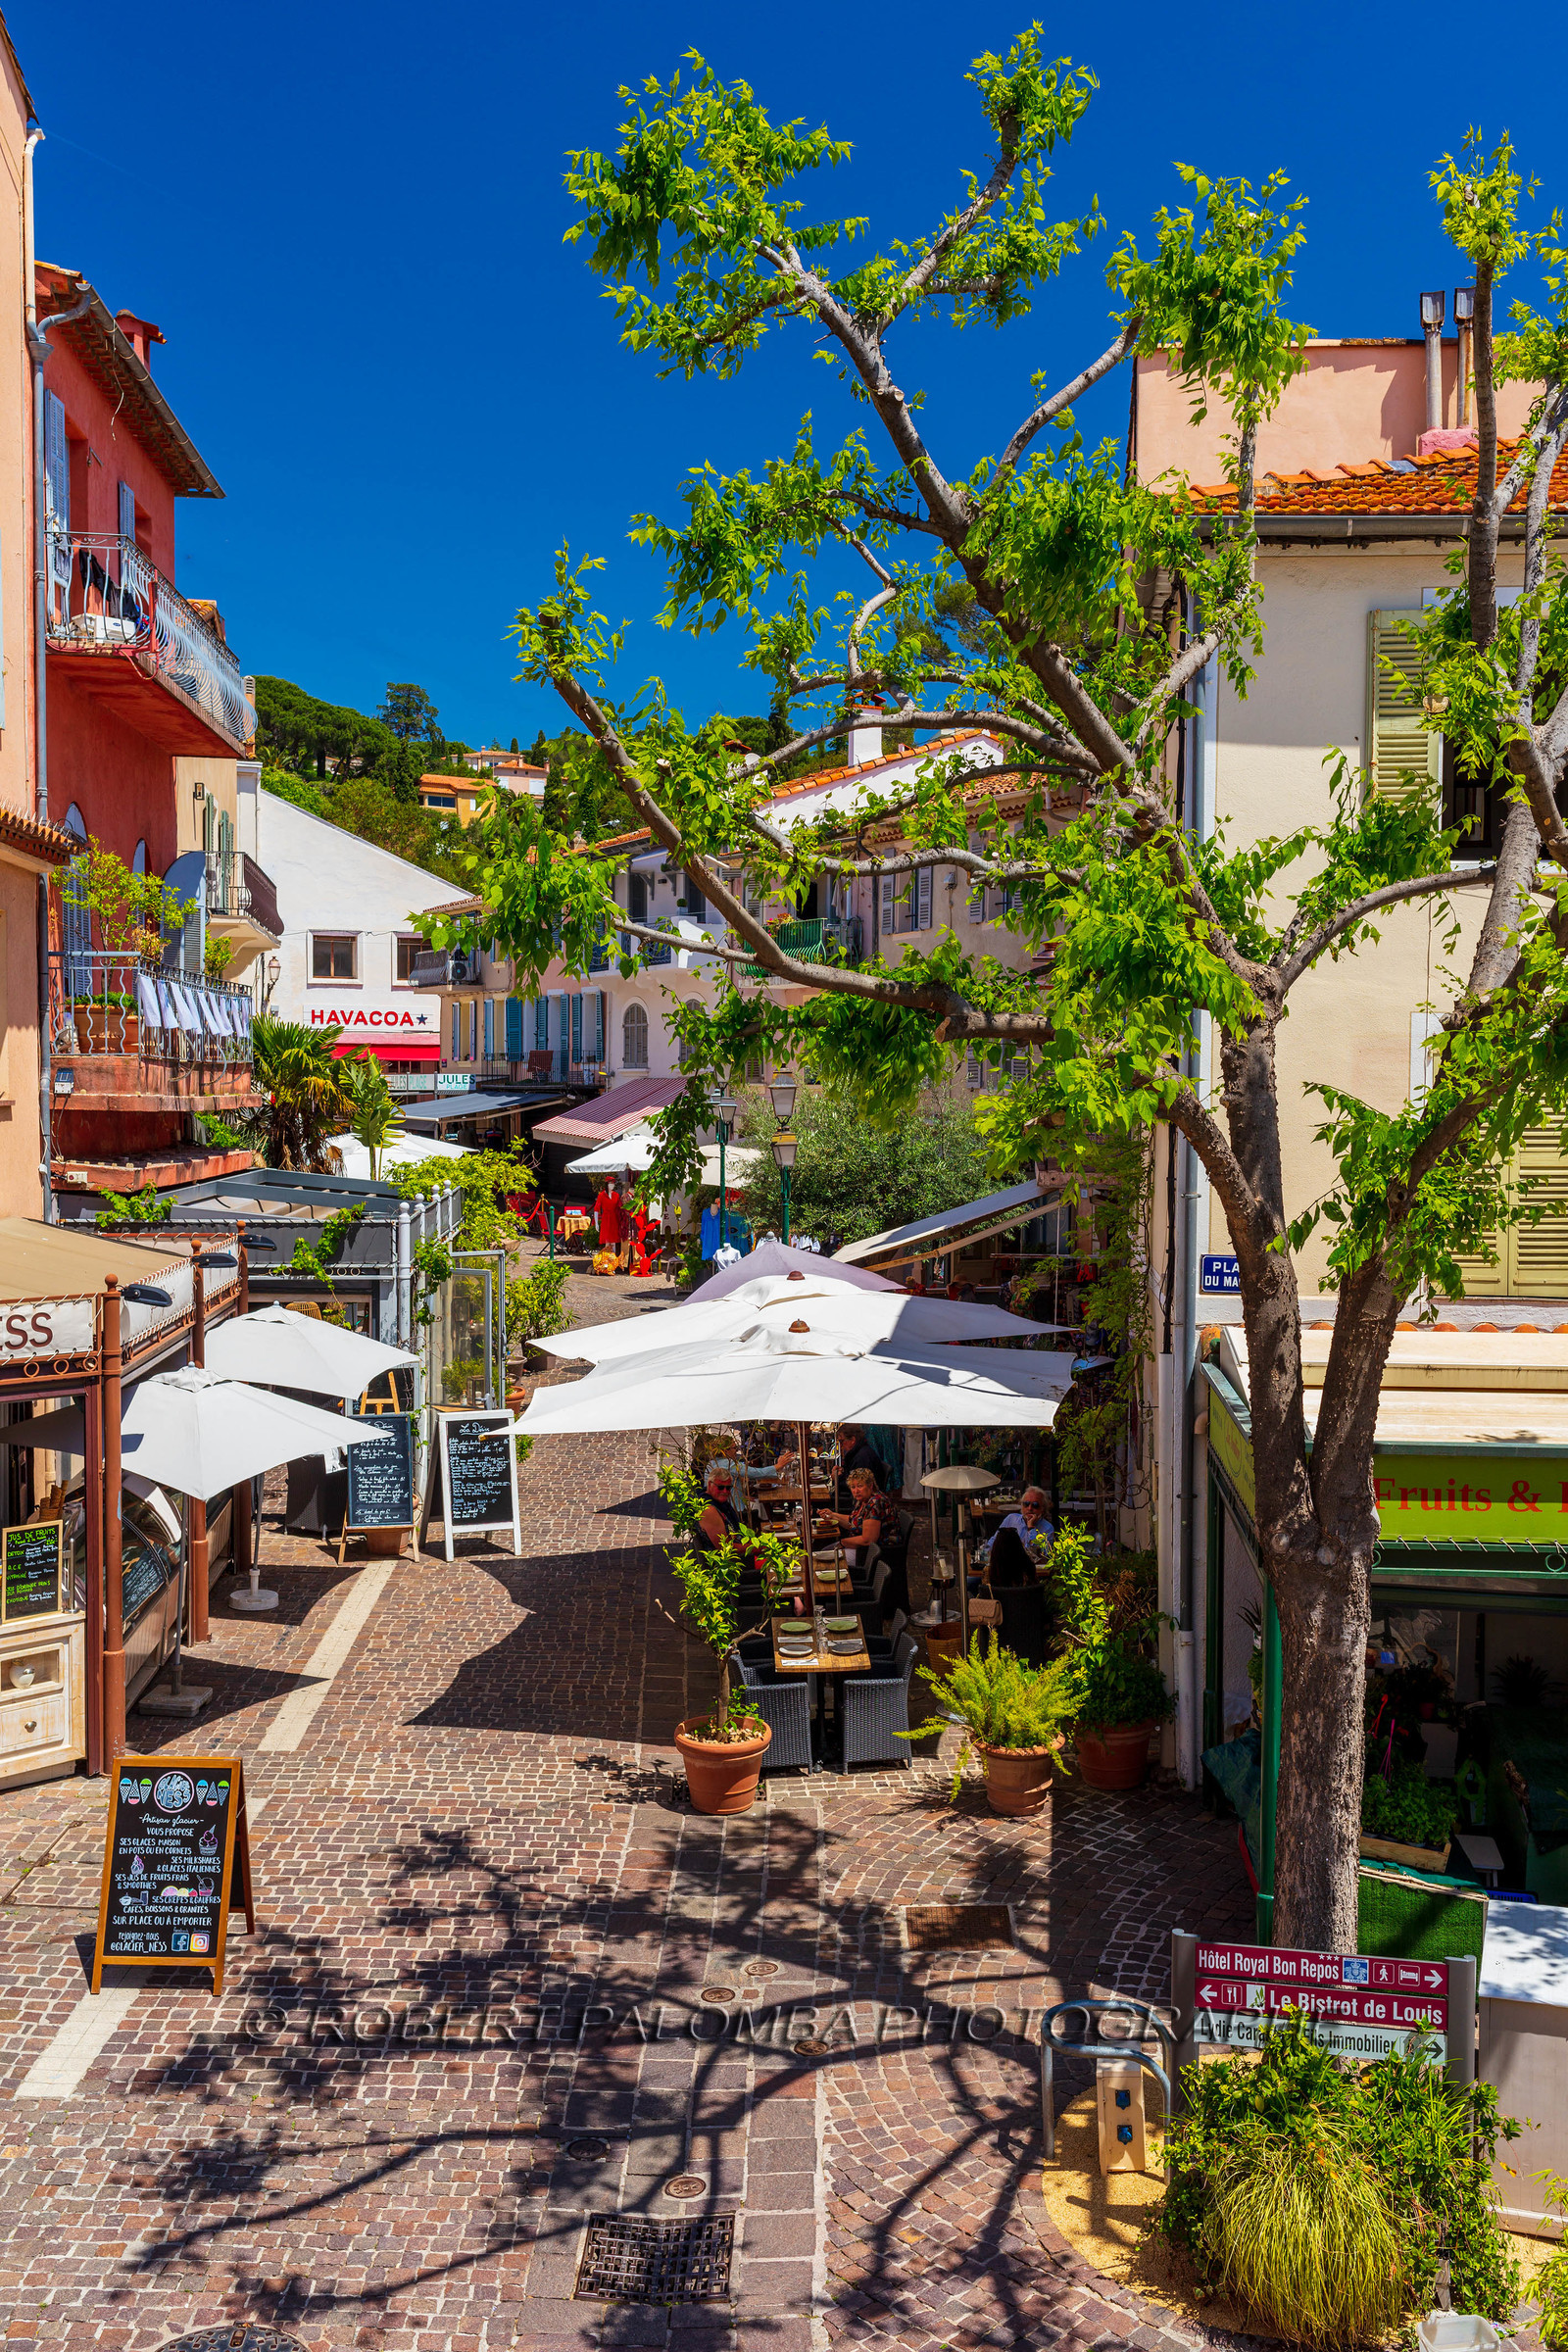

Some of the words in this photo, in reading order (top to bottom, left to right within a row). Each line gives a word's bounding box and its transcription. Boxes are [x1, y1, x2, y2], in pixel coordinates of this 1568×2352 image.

[311, 1009, 415, 1027] HAVACOA
[409, 1075, 427, 1089] PLAGE
[438, 1074, 476, 1085] JULES
[1204, 1275, 1219, 1287] DU
[1223, 1276, 1241, 1288] MA
[0, 1311, 54, 1351] SS
[1373, 1478, 1493, 1512] Fruits
[1507, 1480, 1544, 1513] &
[7, 1533, 22, 1543] JUS
[35, 1527, 56, 1537] FRUITS
[157, 1788, 191, 1809] NESS
[146, 1827, 165, 1836] VOUS
[165, 1828, 194, 1837] PROPOSE
[119, 1838, 131, 1846] SES
[132, 1838, 156, 1846] GLACES
[158, 1838, 181, 1846] MAISON
[183, 1856, 221, 1865] MILKSHAKES
[186, 1864, 221, 1874] ITALIENNES
[150, 1873, 172, 1882] FRUITS
[144, 1904, 173, 1913] BOISSONS
[179, 1904, 209, 1914] GRANITÉS
[112, 1915, 127, 1925] SUR
[128, 1916, 153, 1925] PLACE
[154, 1917, 166, 1926] OU
[166, 1915, 172, 1926] À
[172, 1916, 213, 1927] EMPORTER
[110, 1941, 168, 1953] @GLACIER_NESS
[1199, 1949, 1231, 1971] Hôtel
[1235, 1952, 1269, 1977] Royal
[1273, 1955, 1297, 1976] Bon
[1300, 1958, 1340, 1983] Repos
[1270, 1989, 1293, 2010] Le
[1298, 1992, 1358, 2017] Bistrot
[1363, 1999, 1386, 2019] de
[1393, 2001, 1443, 2025] Louis
[1200, 2019, 1233, 2040] Lydie
[1329, 2031, 1396, 2055] Immobilier
